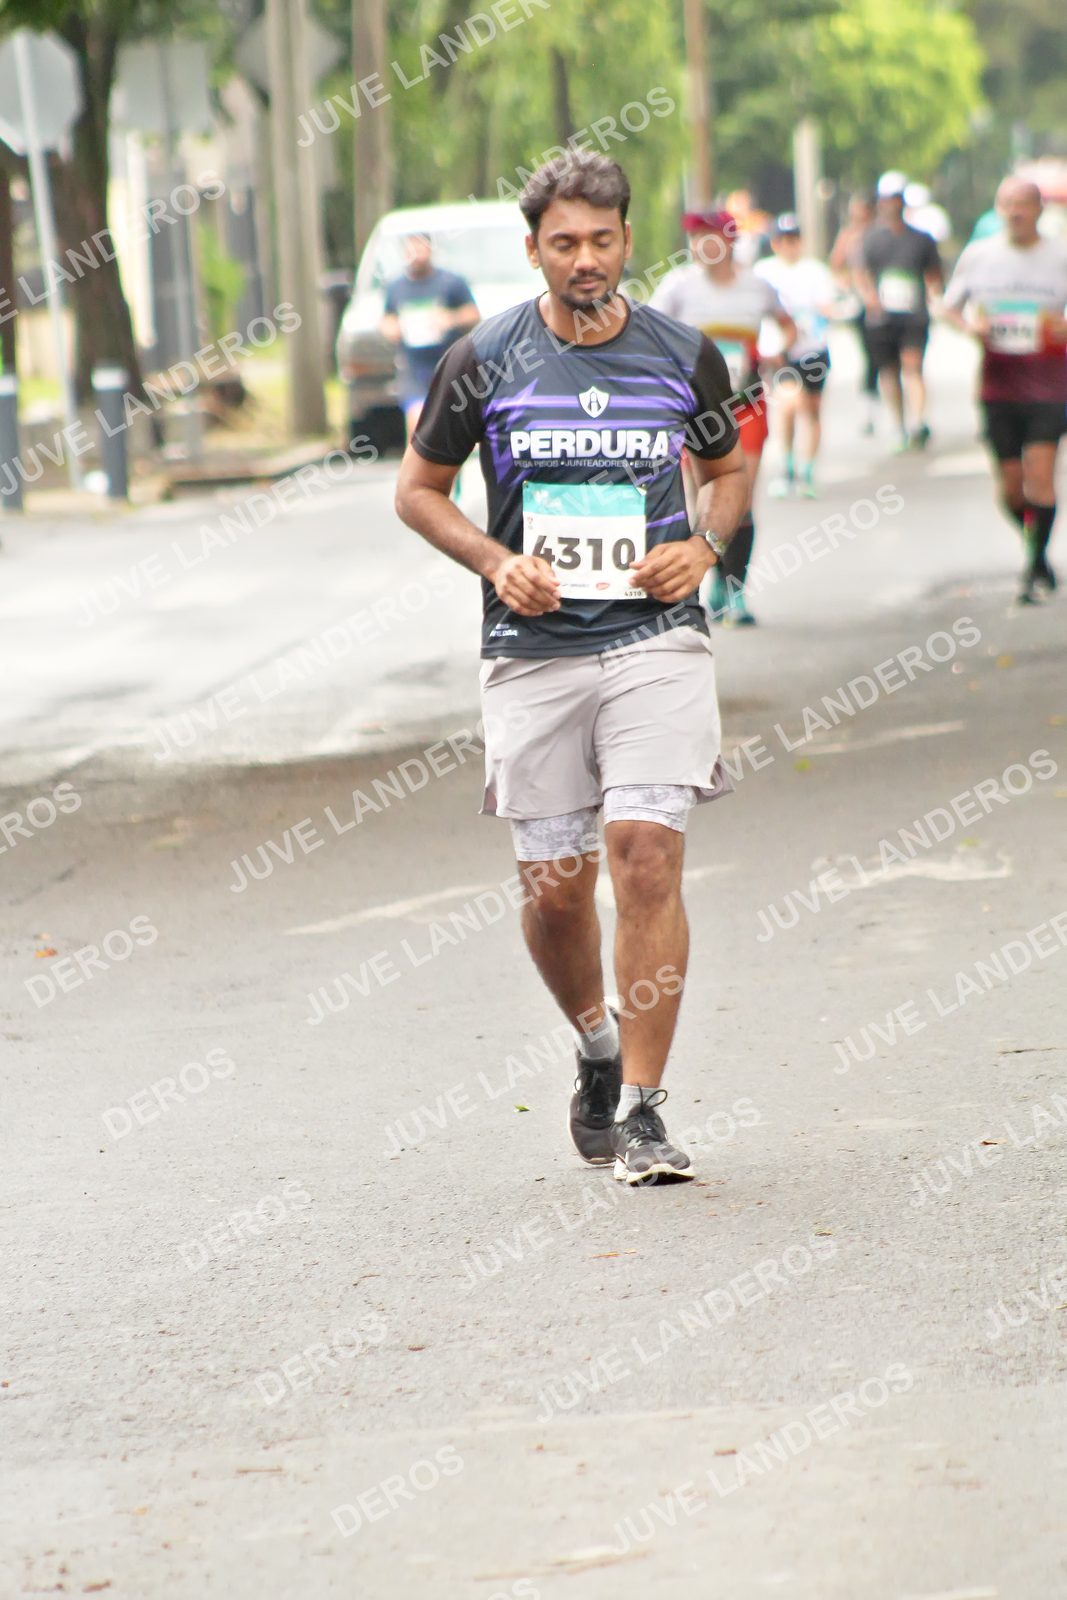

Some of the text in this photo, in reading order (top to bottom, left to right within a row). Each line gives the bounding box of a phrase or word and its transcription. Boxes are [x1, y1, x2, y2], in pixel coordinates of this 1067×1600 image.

[510, 430, 669, 459] PERDURA
[565, 459, 628, 468] JUNTEADORES
[532, 535, 636, 571] 4310
